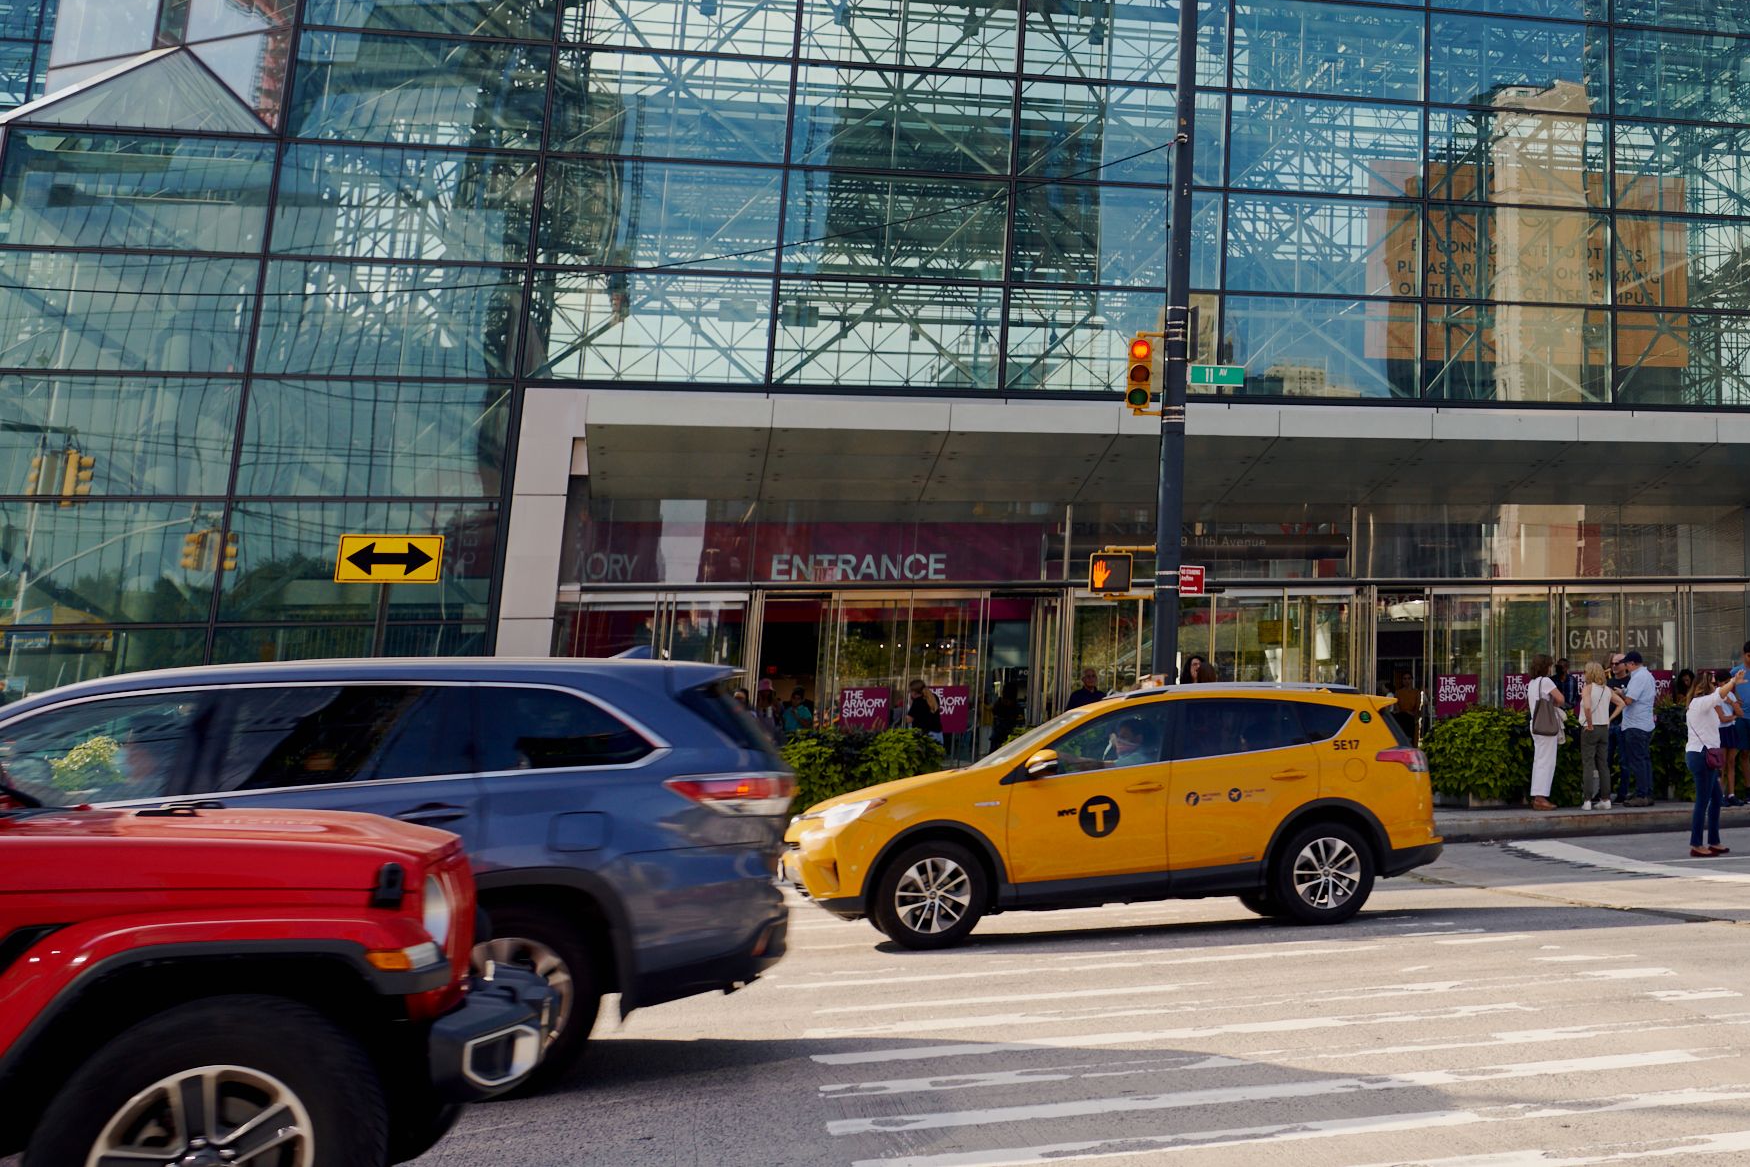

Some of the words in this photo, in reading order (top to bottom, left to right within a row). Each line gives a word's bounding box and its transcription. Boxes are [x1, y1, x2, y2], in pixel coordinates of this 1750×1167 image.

[1205, 367, 1213, 383] 11
[1221, 535, 1266, 547] Avenue
[770, 553, 947, 581] ENTRANCE
[1439, 676, 1457, 686] THE
[1506, 675, 1523, 684] THE
[1439, 684, 1476, 694] ARMORY
[1506, 683, 1530, 692] ARMO
[844, 689, 864, 699] THE
[1439, 693, 1466, 702] SHOW
[842, 698, 887, 709] ARMORY
[842, 707, 875, 718] SHOW
